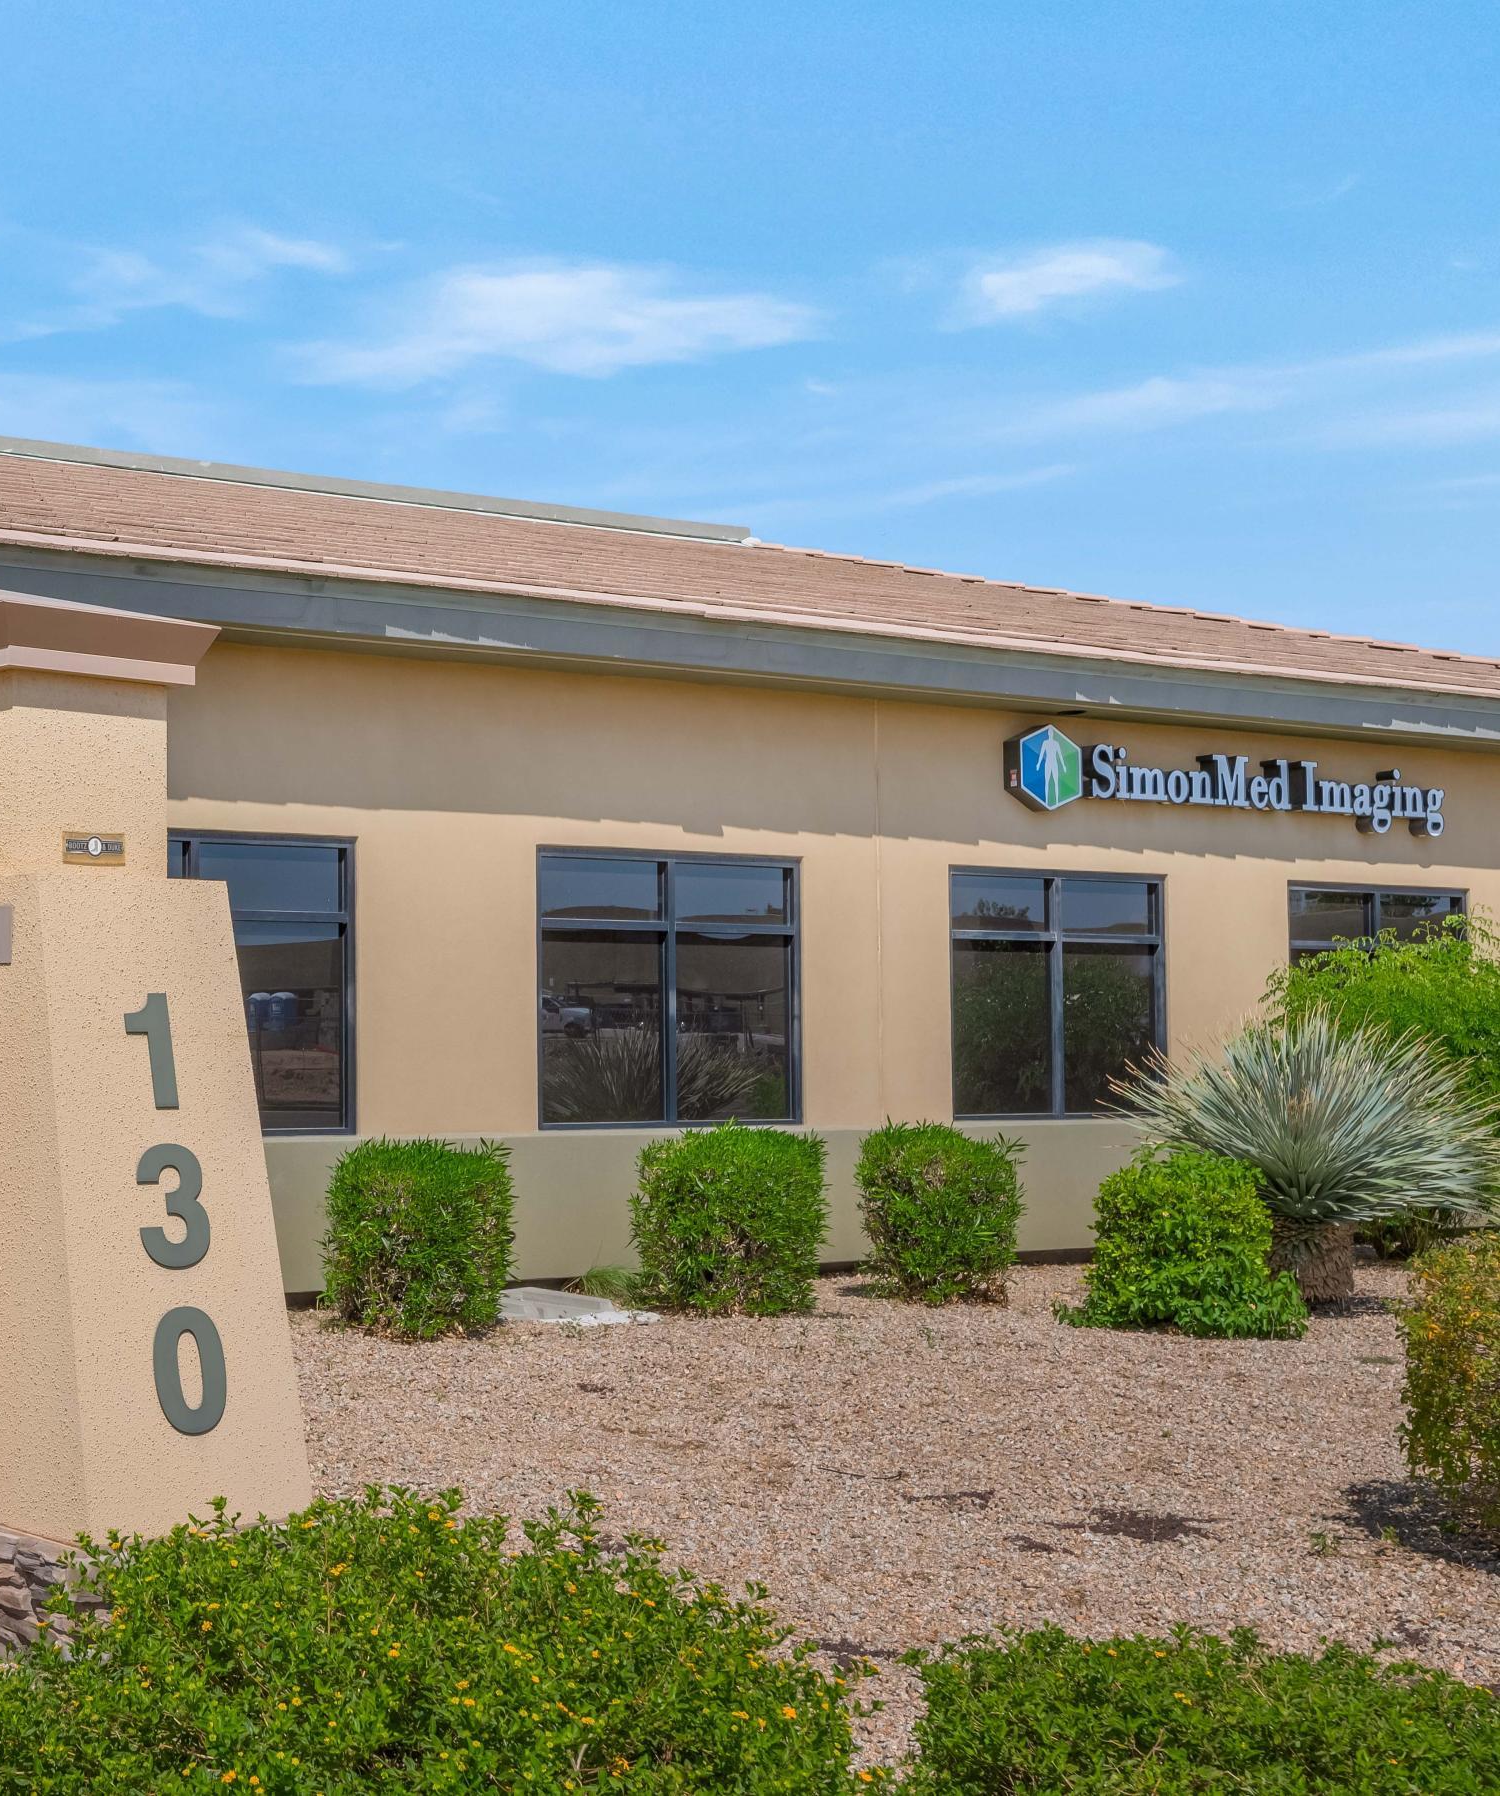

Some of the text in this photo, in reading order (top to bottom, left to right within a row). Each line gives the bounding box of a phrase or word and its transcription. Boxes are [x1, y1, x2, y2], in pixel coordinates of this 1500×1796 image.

[1092, 744, 1445, 837] SimonMed Imaging
[68, 841, 88, 850] BOOTZ
